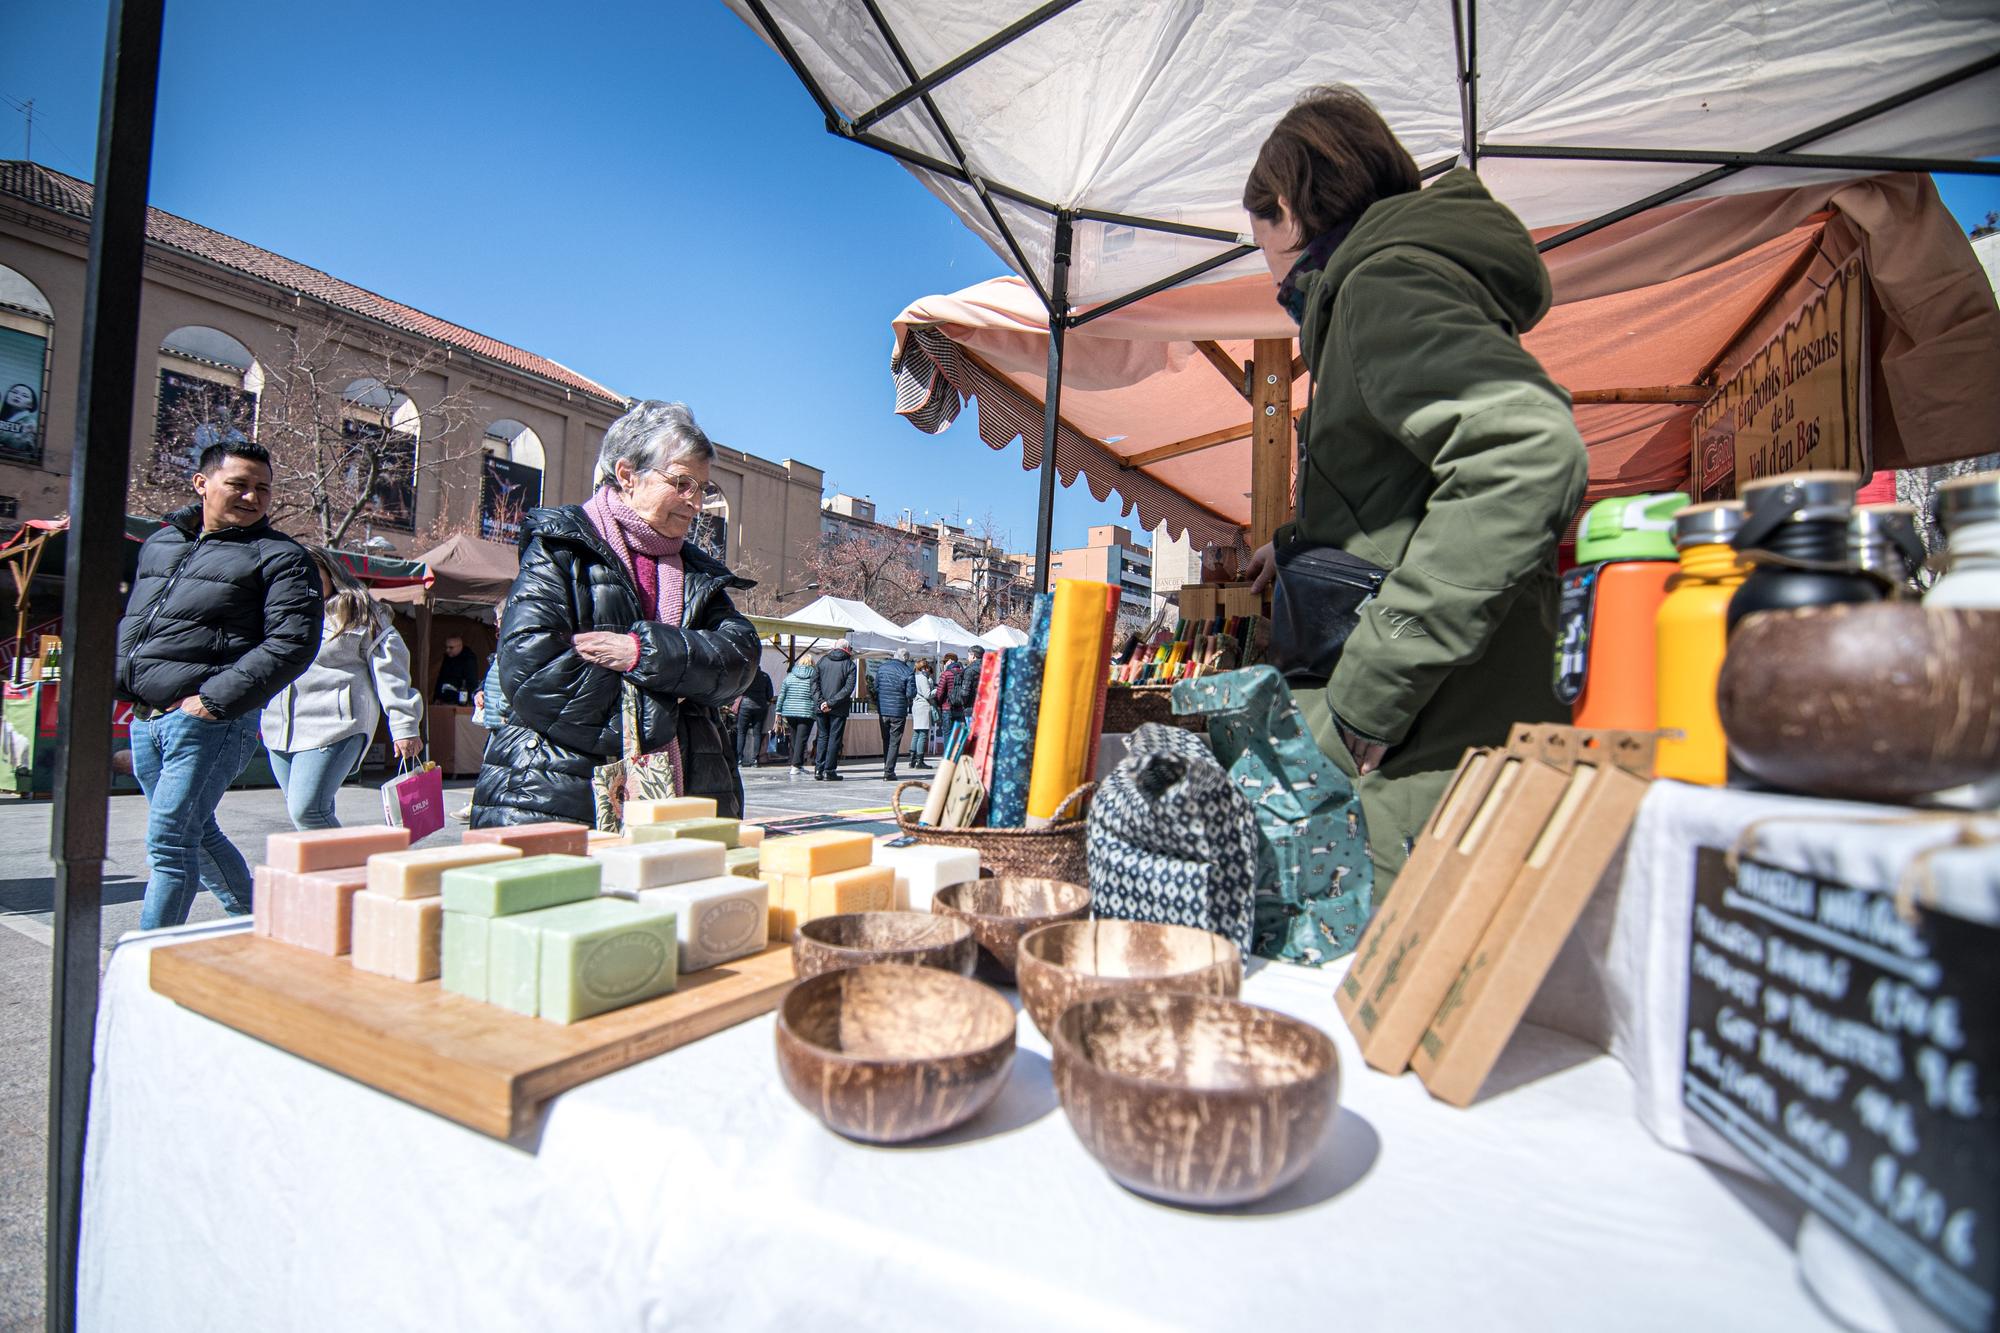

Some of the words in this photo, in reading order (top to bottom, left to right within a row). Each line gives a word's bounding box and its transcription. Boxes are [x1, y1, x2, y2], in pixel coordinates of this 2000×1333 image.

[1783, 331, 1839, 387] Artesans
[1771, 401, 1784, 434] de
[1785, 395, 1795, 425] la
[1770, 434, 1794, 476] d'en
[1797, 416, 1821, 463] Bas
